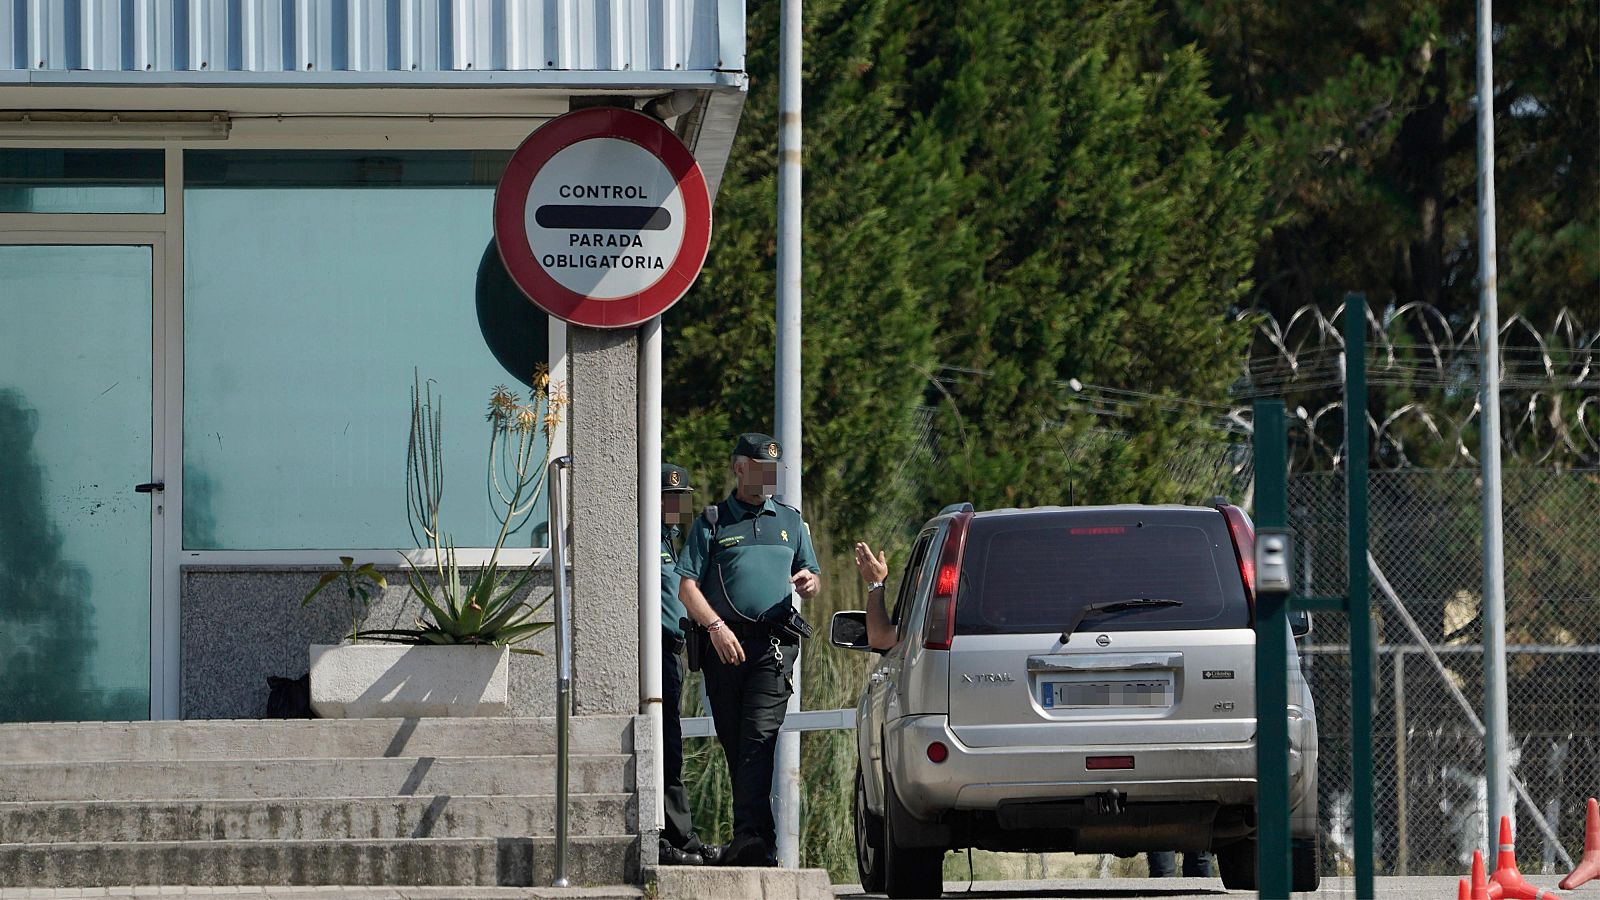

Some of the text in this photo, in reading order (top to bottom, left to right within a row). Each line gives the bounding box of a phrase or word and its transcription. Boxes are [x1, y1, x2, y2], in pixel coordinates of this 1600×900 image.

[559, 184, 648, 199] CONTROL
[569, 233, 643, 248] PARADA
[542, 254, 665, 270] OBLIGATORIA
